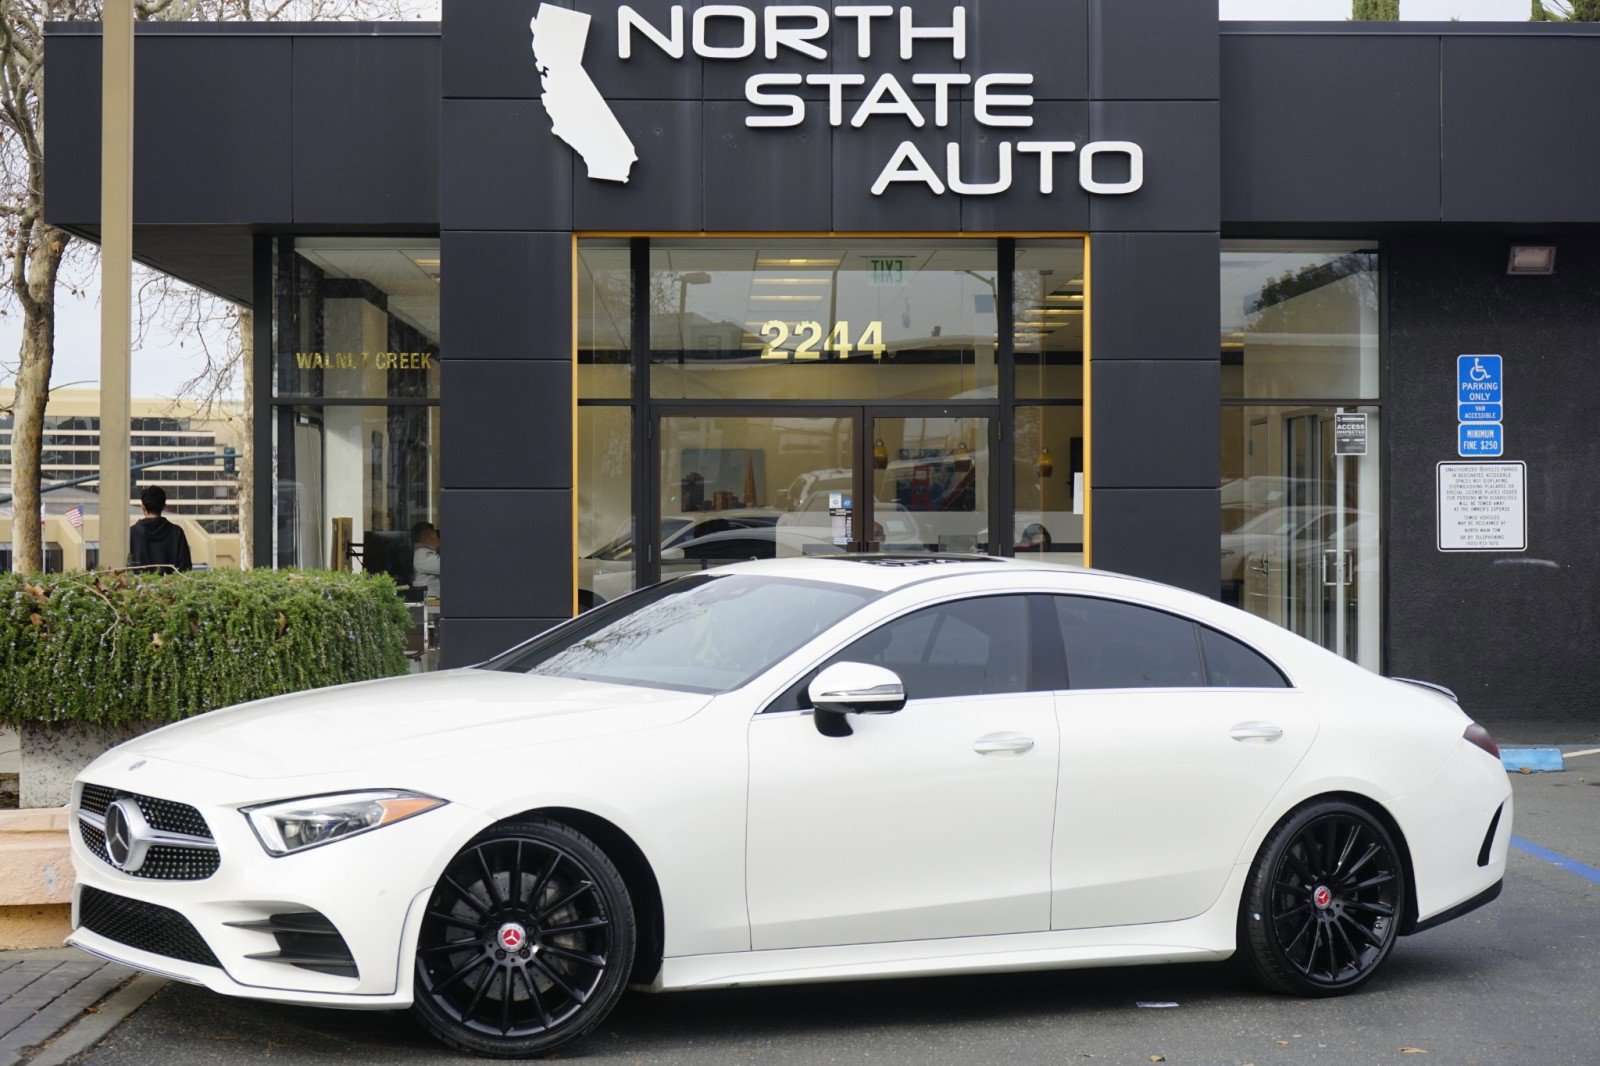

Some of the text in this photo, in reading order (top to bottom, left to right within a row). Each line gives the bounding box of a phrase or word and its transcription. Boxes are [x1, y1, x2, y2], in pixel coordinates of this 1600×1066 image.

[618, 5, 966, 59] NORTH
[745, 73, 1034, 127] STATE
[871, 141, 1144, 195] AUTO
[761, 319, 886, 359] 2244
[296, 352, 432, 369] WALNUT CREEK
[1462, 382, 1498, 390] PARKING
[1469, 392, 1490, 400] ONLY
[1467, 430, 1494, 438] MINIMUM
[1464, 440, 1498, 450] FINE $250
